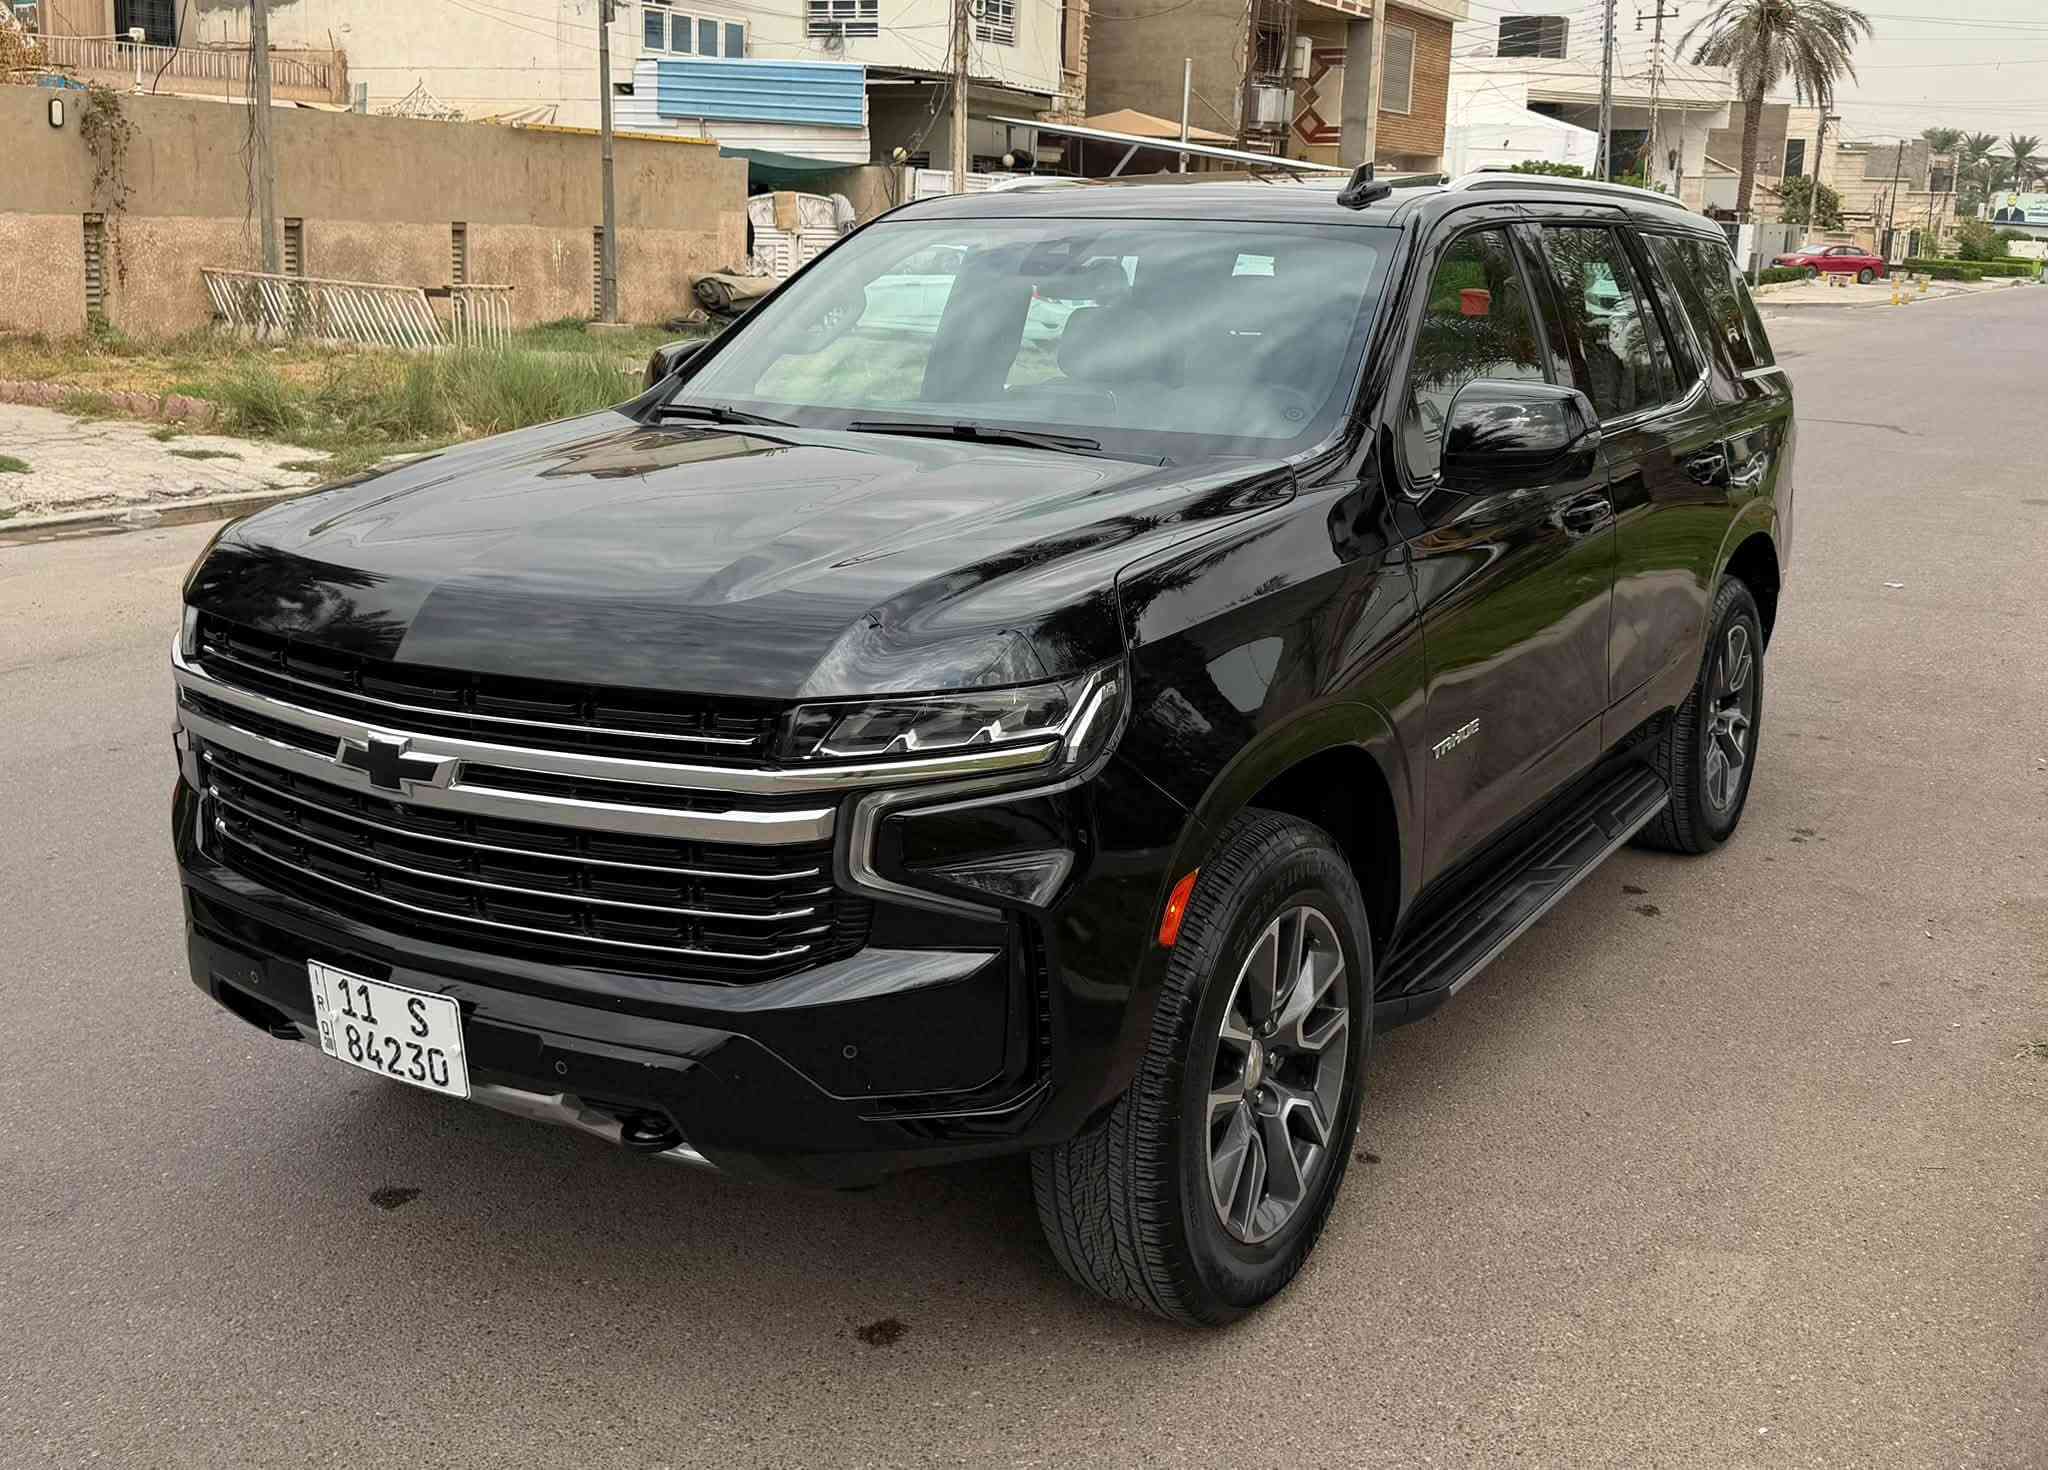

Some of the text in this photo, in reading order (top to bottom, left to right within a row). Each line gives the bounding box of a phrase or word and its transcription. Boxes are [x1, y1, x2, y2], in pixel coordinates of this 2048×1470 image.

[1431, 717, 1480, 760] TAHOE
[338, 977, 429, 1037] 11 S
[345, 1023, 449, 1087] 84230
